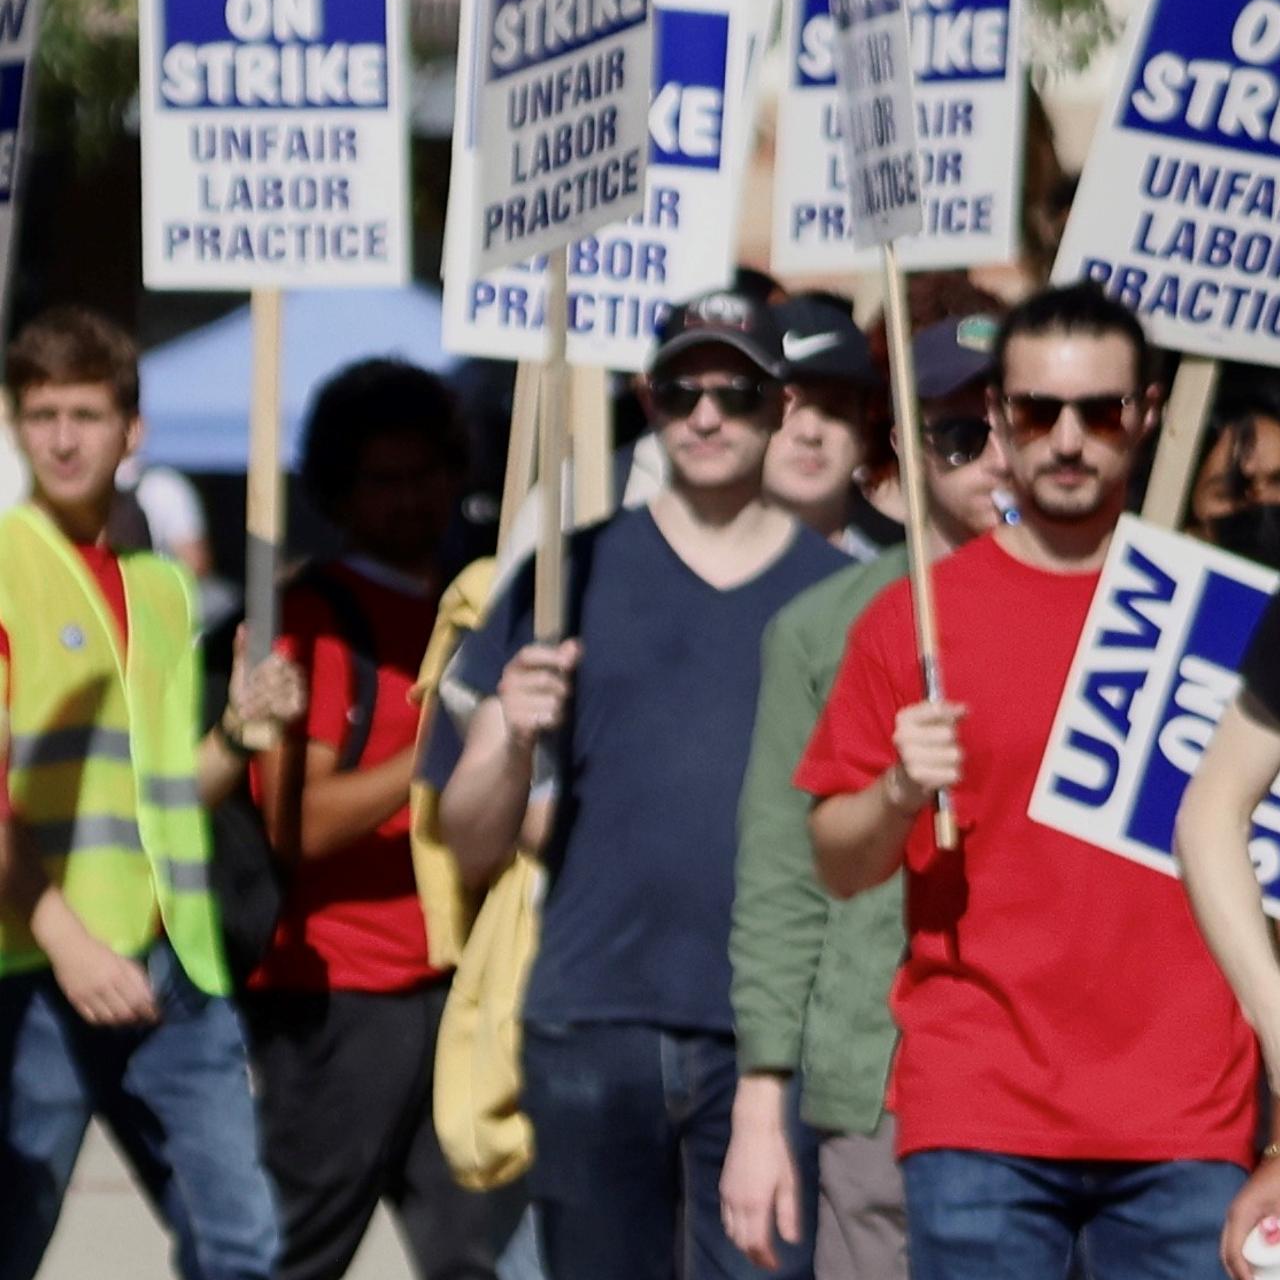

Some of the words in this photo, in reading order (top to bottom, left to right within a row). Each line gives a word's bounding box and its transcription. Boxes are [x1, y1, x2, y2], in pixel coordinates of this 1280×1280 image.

[158, 43, 389, 109] STRIKE
[799, 8, 1008, 82] SIKE
[508, 48, 626, 131] UNFAIR
[190, 126, 358, 162] UNFAIR
[511, 105, 618, 186] LABOR
[199, 175, 351, 212] LABOR
[482, 149, 640, 251] PRACTICE
[164, 222, 389, 263] PRACTICE
[1049, 546, 1179, 809] UAW
